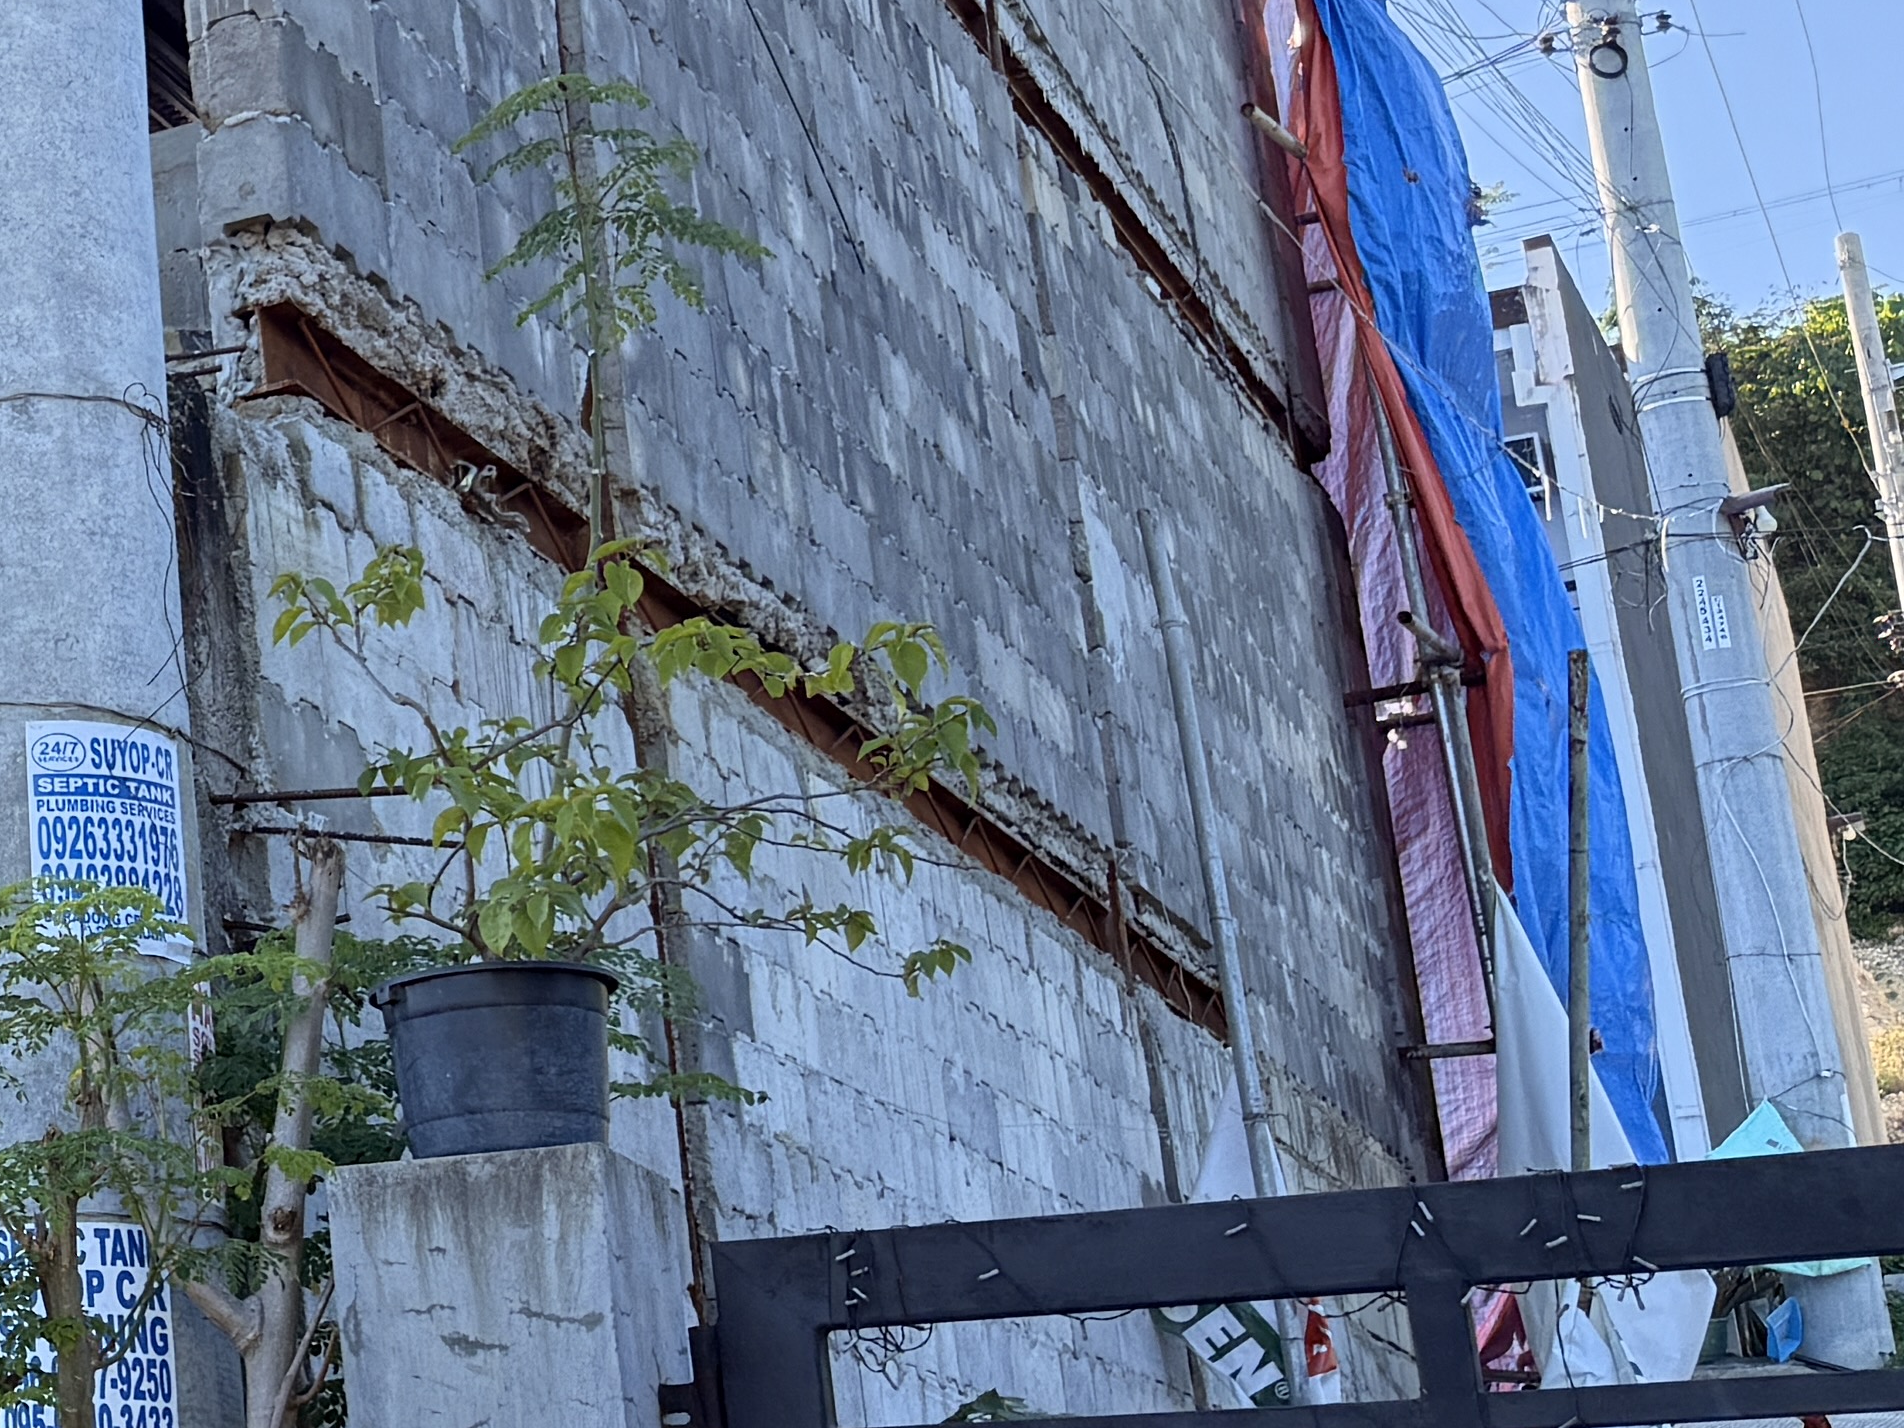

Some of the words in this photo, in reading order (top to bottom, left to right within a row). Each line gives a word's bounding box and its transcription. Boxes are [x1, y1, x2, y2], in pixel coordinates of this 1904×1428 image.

[39, 741, 79, 756] 24/7
[37, 777, 120, 795] SEPTIC
[126, 781, 173, 805] TANK
[36, 798, 116, 814] PLUMBING
[120, 801, 176, 825] SERVICES
[37, 815, 180, 873] 09263331976
